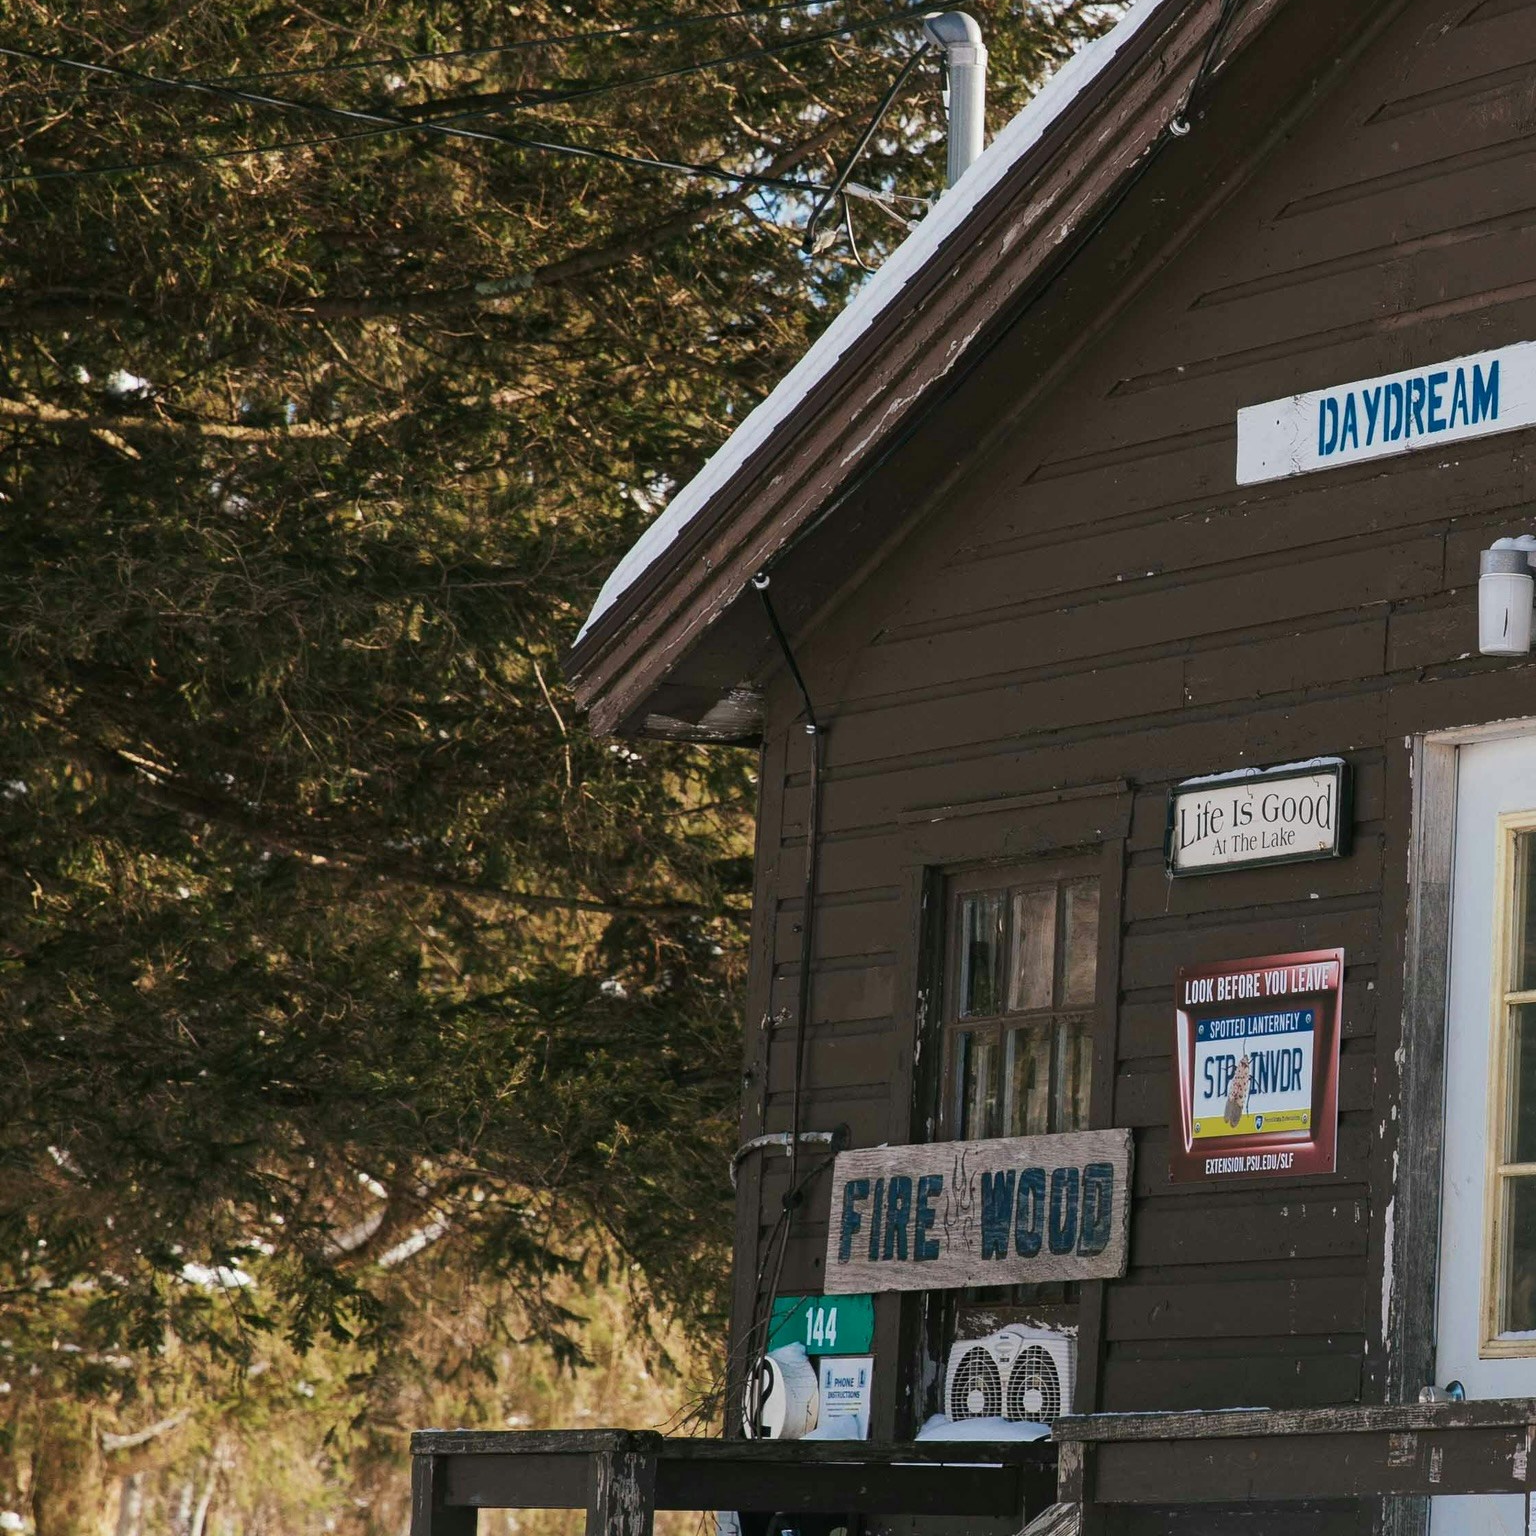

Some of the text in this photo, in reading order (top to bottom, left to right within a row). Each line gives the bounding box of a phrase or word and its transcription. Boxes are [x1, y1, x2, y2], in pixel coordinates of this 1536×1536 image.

[1318, 359, 1500, 456] DAYDREAM
[1180, 783, 1331, 851] Life Is Good
[1212, 827, 1296, 856] At The Lake
[1185, 965, 1329, 1005] LOOK BEFORE YOU LEAVE
[1209, 1012, 1300, 1039] SPOTTED LANTERNFLY
[1205, 1152, 1294, 1175] EXTENSION.PSU.EDU/SLF
[838, 1174, 944, 1264] FIRE
[980, 1162, 1114, 1261] WOOD
[805, 1306, 838, 1347] 144
[827, 1390, 861, 1399] INSTRUCTIONS
[834, 1377, 854, 1388] PHONE
